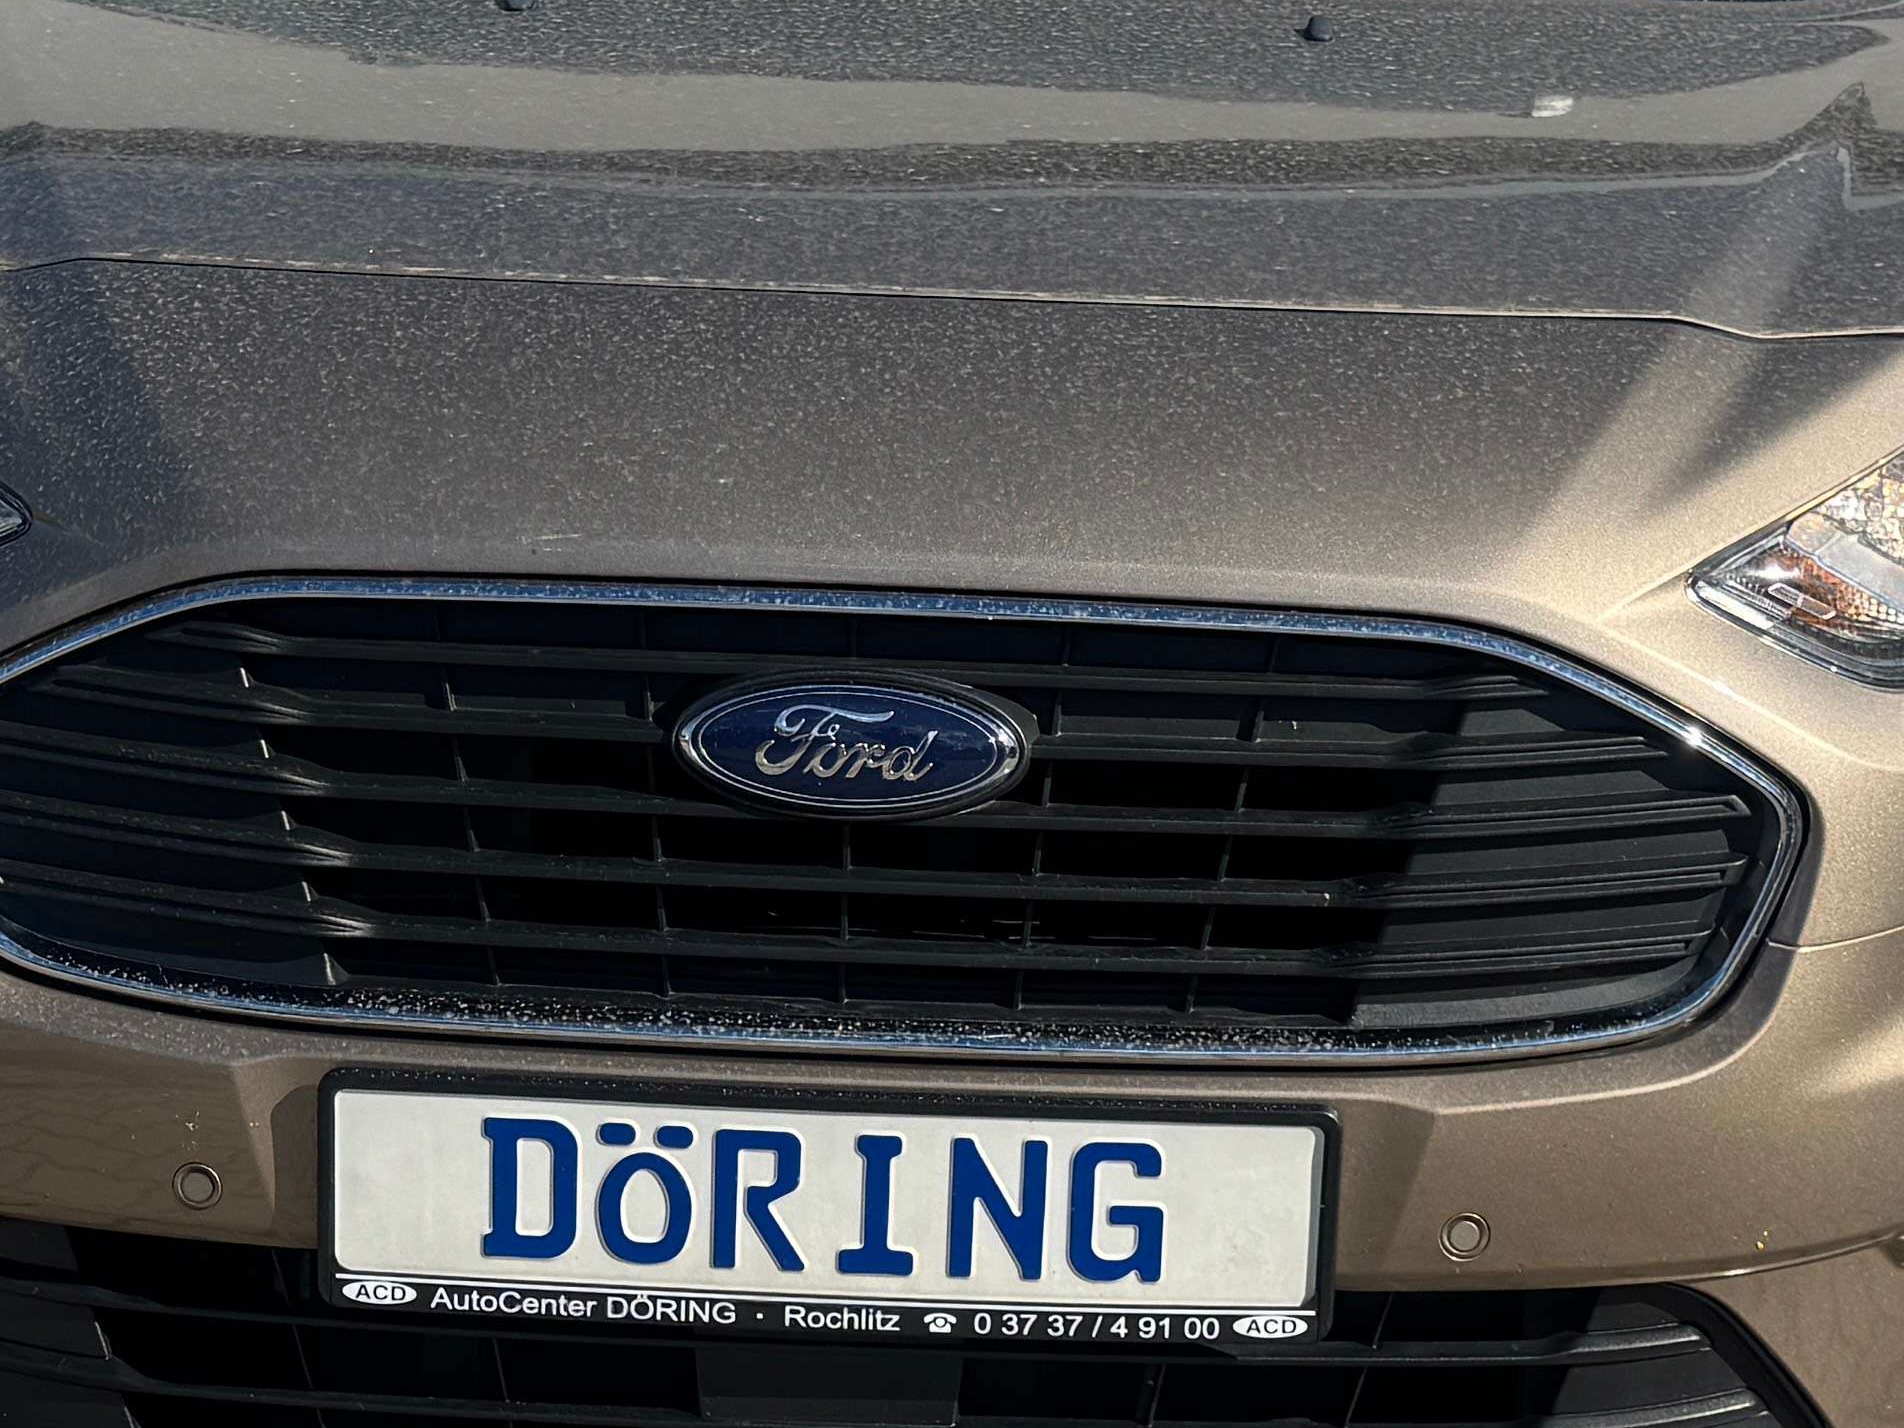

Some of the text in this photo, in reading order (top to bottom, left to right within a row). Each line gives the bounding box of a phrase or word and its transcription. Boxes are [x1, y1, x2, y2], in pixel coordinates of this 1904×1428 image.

[754, 704, 939, 782] Ford
[483, 1117, 1164, 1284] DÖRING
[354, 1283, 408, 1302] ACD
[429, 1285, 599, 1319] AutoCenter
[605, 1292, 737, 1325] DÖRING
[783, 1305, 902, 1332] Rochlitz
[1000, 1312, 1039, 1337] 37
[1046, 1314, 1085, 1338] 37
[1137, 1316, 1171, 1340] 91
[1182, 1317, 1221, 1341] 00
[1244, 1317, 1298, 1338] ACD
